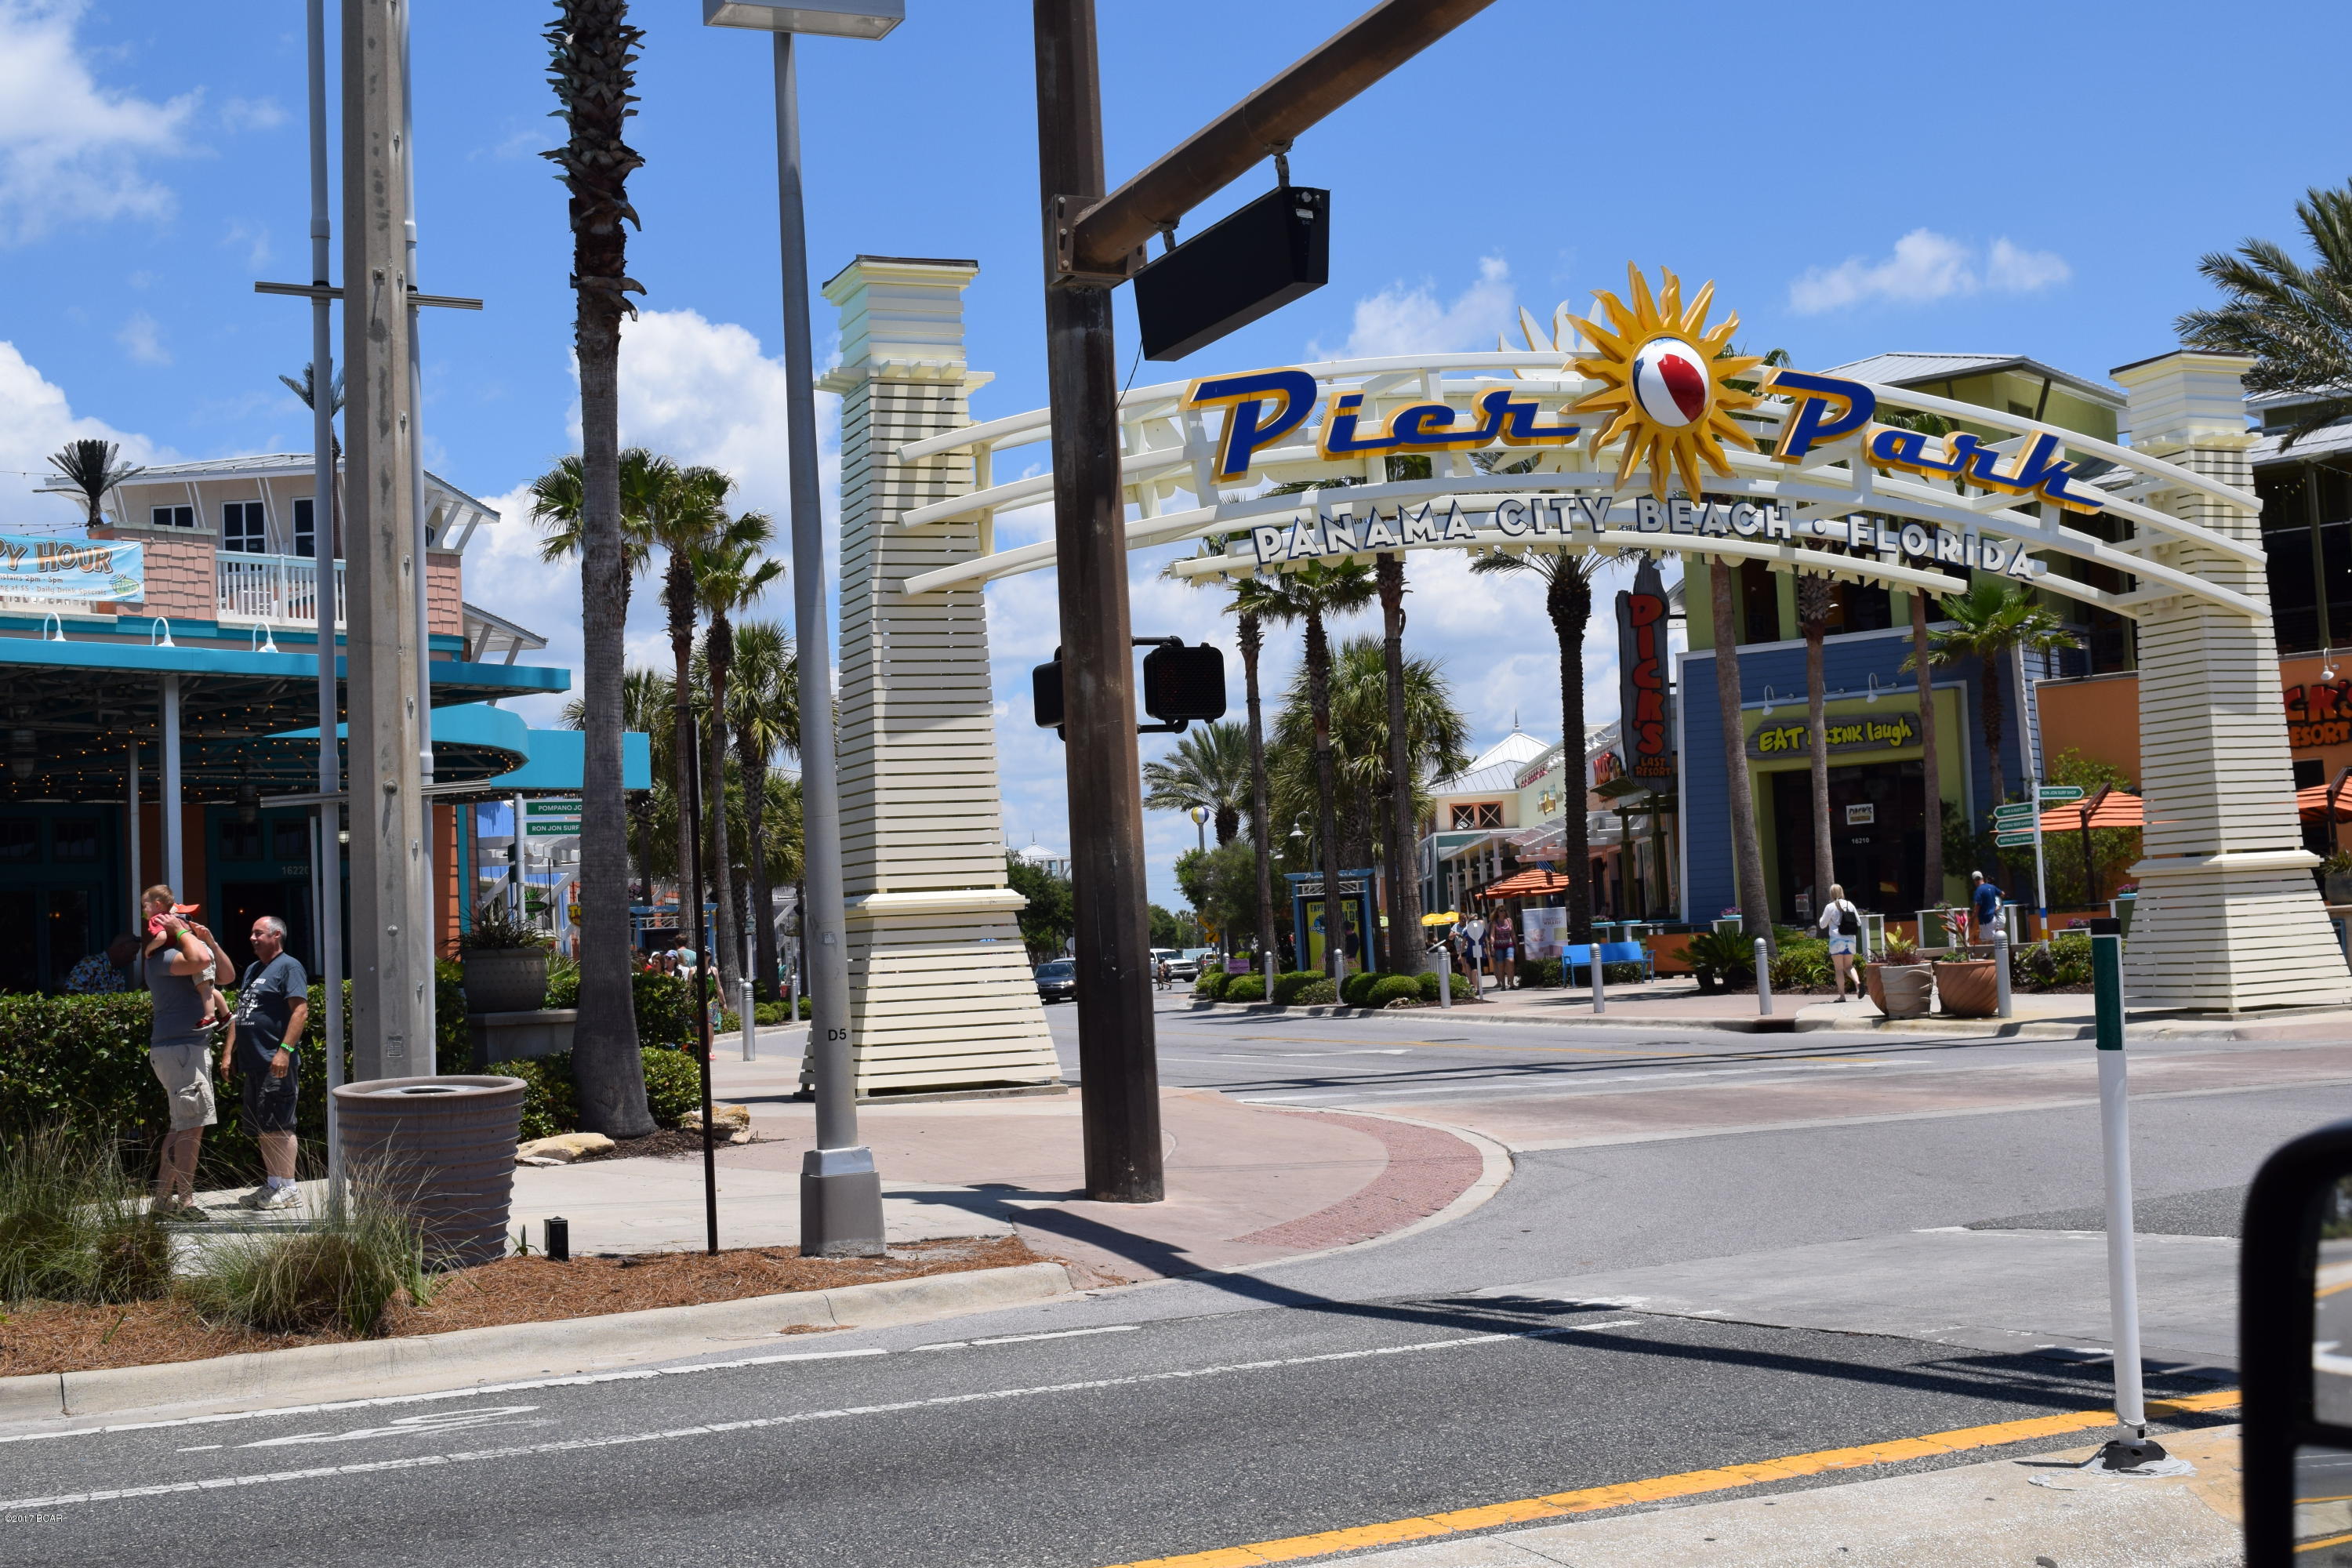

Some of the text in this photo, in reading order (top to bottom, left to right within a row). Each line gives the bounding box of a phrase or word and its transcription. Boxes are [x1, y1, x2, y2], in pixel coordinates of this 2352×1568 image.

[1178, 367, 2104, 515] Pier Park
[1251, 496, 2034, 581] PANAMA CITY BEACH FLORIDA
[34, 541, 113, 574] HOUR
[37, 586, 55, 594] Daily
[48, 576, 64, 585] 5pm
[1628, 593, 1664, 755] DICK'S
[1759, 717, 1913, 752] EAT INK laugh
[1635, 766, 1671, 777] RESORT
[1639, 757, 1667, 767] LAST
[828, 1029, 847, 1042] D5
